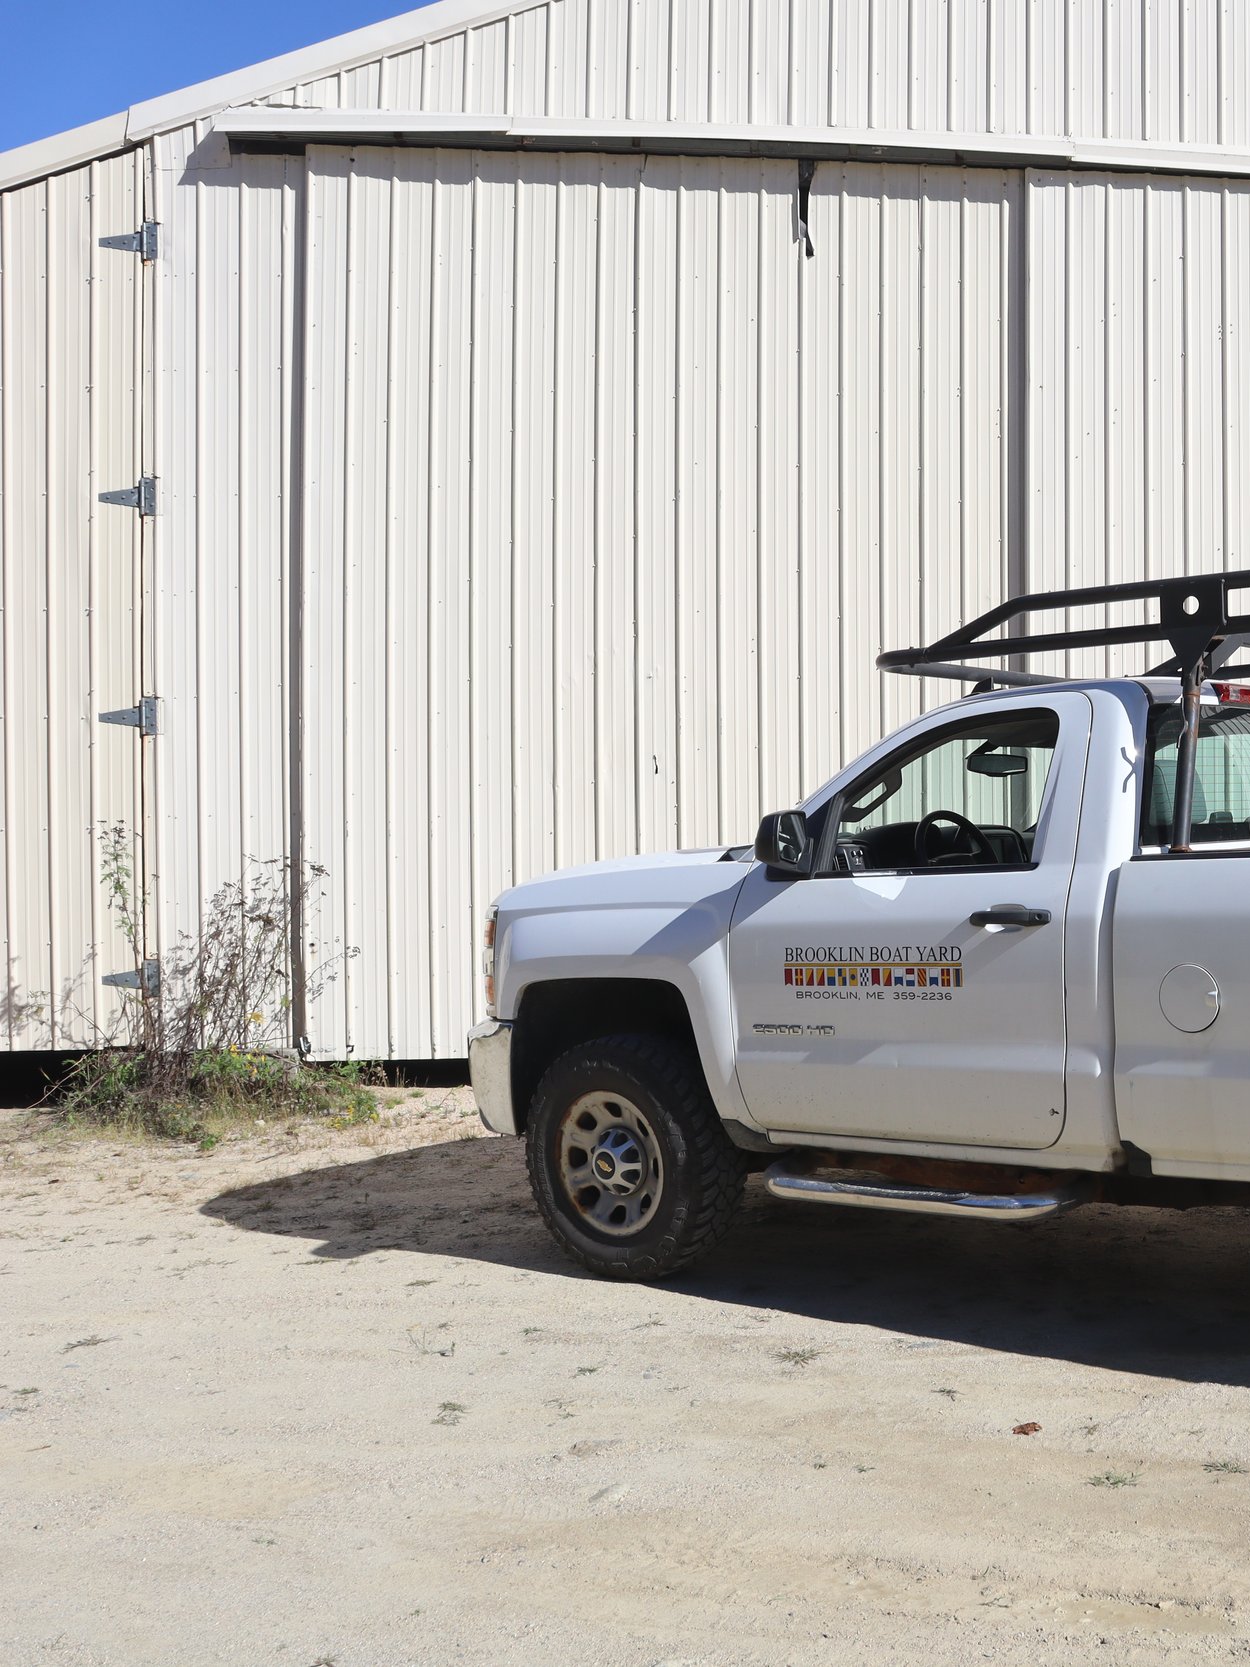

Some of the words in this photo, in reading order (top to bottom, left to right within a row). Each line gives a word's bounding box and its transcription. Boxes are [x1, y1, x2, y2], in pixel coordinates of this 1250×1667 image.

[784, 946, 865, 963] BROOKLIN
[869, 946, 912, 962] BOAT
[915, 946, 962, 962] YARD
[795, 991, 861, 1001] BROOKLIN,
[866, 991, 885, 1000] ME
[893, 991, 953, 1001] 359-2236
[752, 1023, 804, 1036] 2500
[806, 1024, 836, 1037] HD
